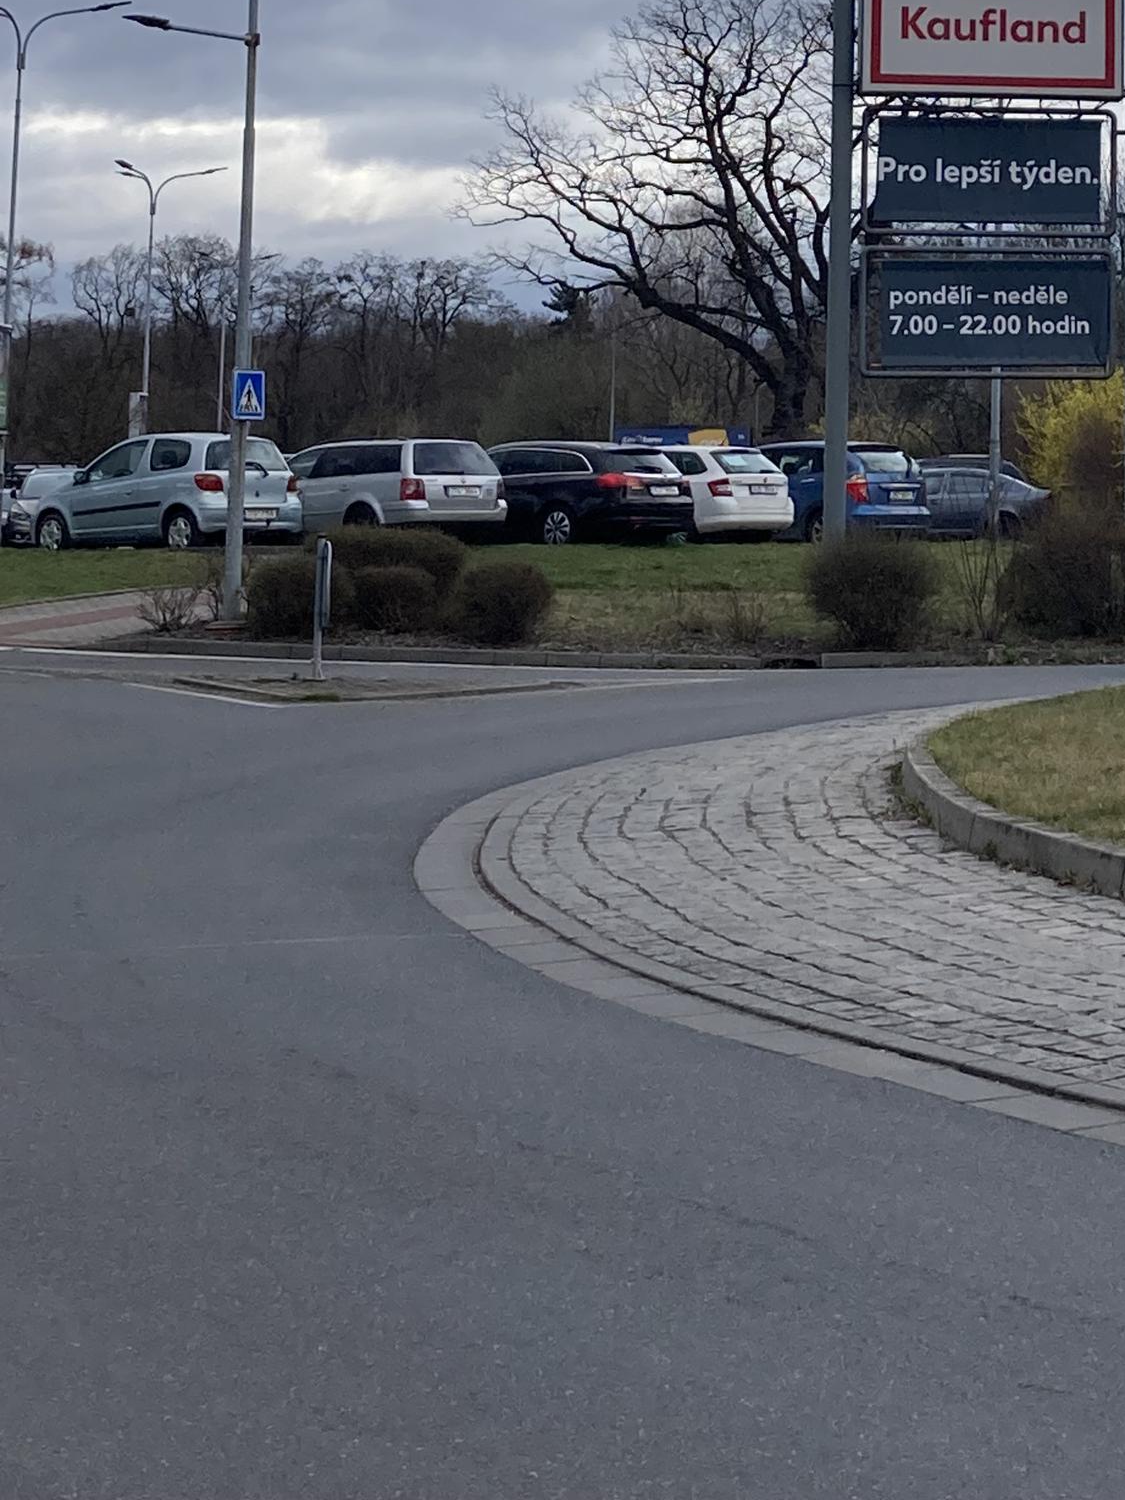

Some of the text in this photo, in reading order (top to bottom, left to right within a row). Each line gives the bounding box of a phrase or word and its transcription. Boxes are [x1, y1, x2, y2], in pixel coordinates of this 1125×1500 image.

[900, 6, 1087, 44] Kaufland
[878, 156, 1099, 190] Pro lepší týden.
[889, 285, 973, 310] pondělí
[994, 285, 1068, 305] neděle
[889, 315, 938, 335] 7.00
[959, 315, 1021, 335] 22.00
[1027, 315, 1090, 335] hodin
